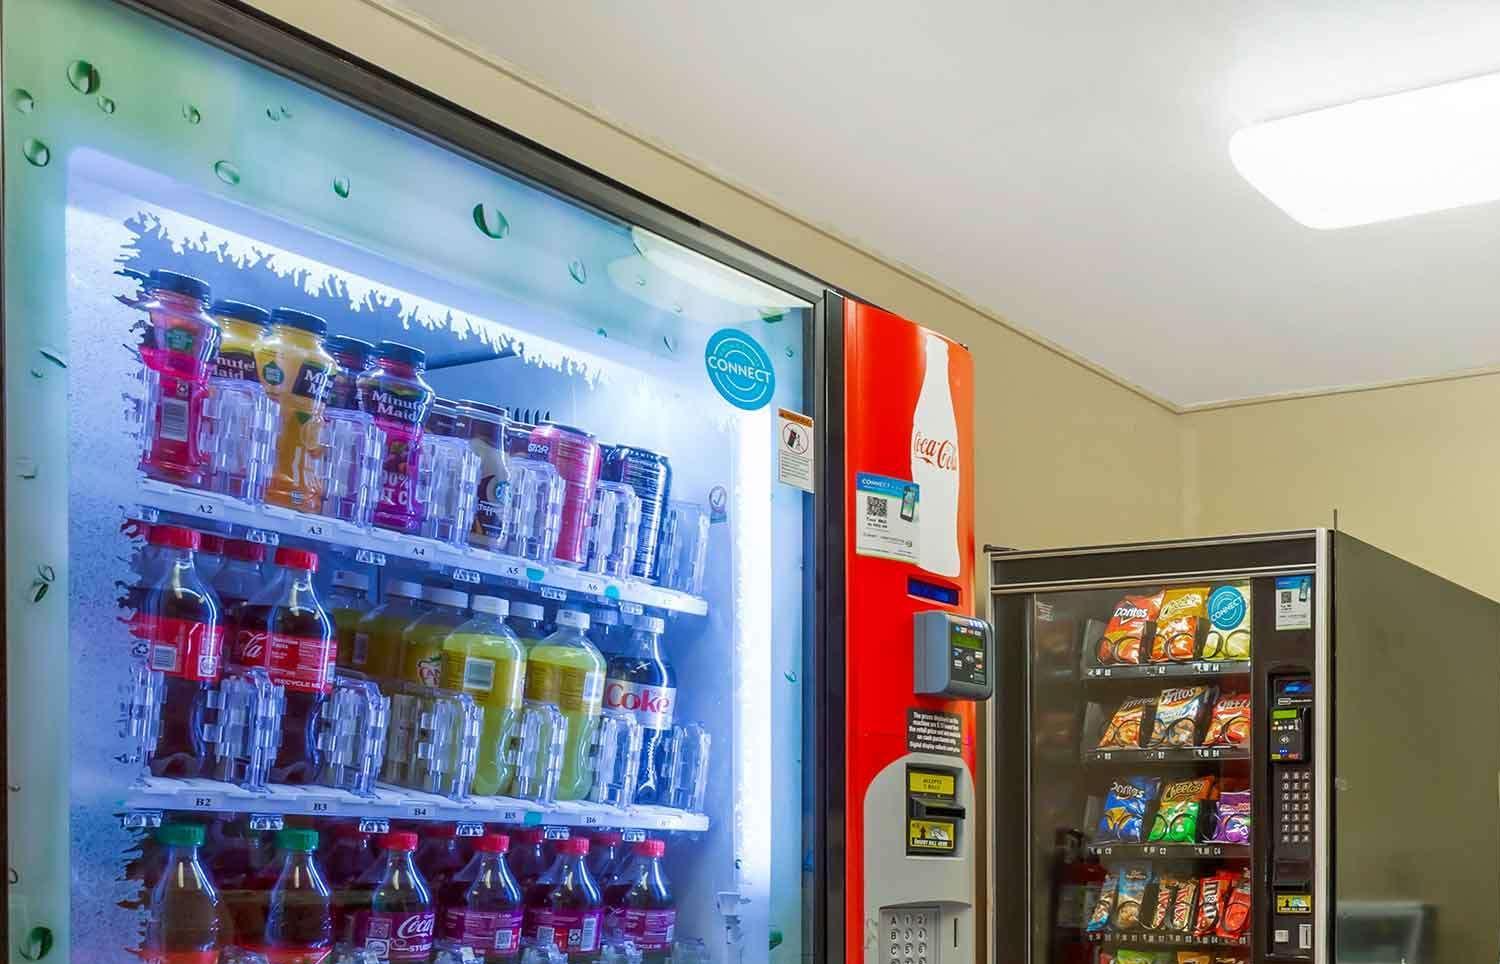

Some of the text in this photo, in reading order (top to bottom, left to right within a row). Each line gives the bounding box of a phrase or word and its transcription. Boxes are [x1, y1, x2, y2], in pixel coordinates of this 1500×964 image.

[707, 355, 772, 385] CONNECT
[377, 402, 418, 422] Maid
[198, 504, 213, 514] A2
[308, 526, 322, 536] A3
[413, 547, 425, 556] A4
[506, 567, 519, 576] A5
[587, 583, 599, 591] A6
[1113, 606, 1148, 619] Doritos
[606, 683, 672, 713] Coke
[1162, 687, 1195, 706] Fritos
[195, 798, 211, 807] B2
[313, 802, 328, 811] B3
[414, 808, 426, 816] B4
[586, 816, 597, 825] B6
